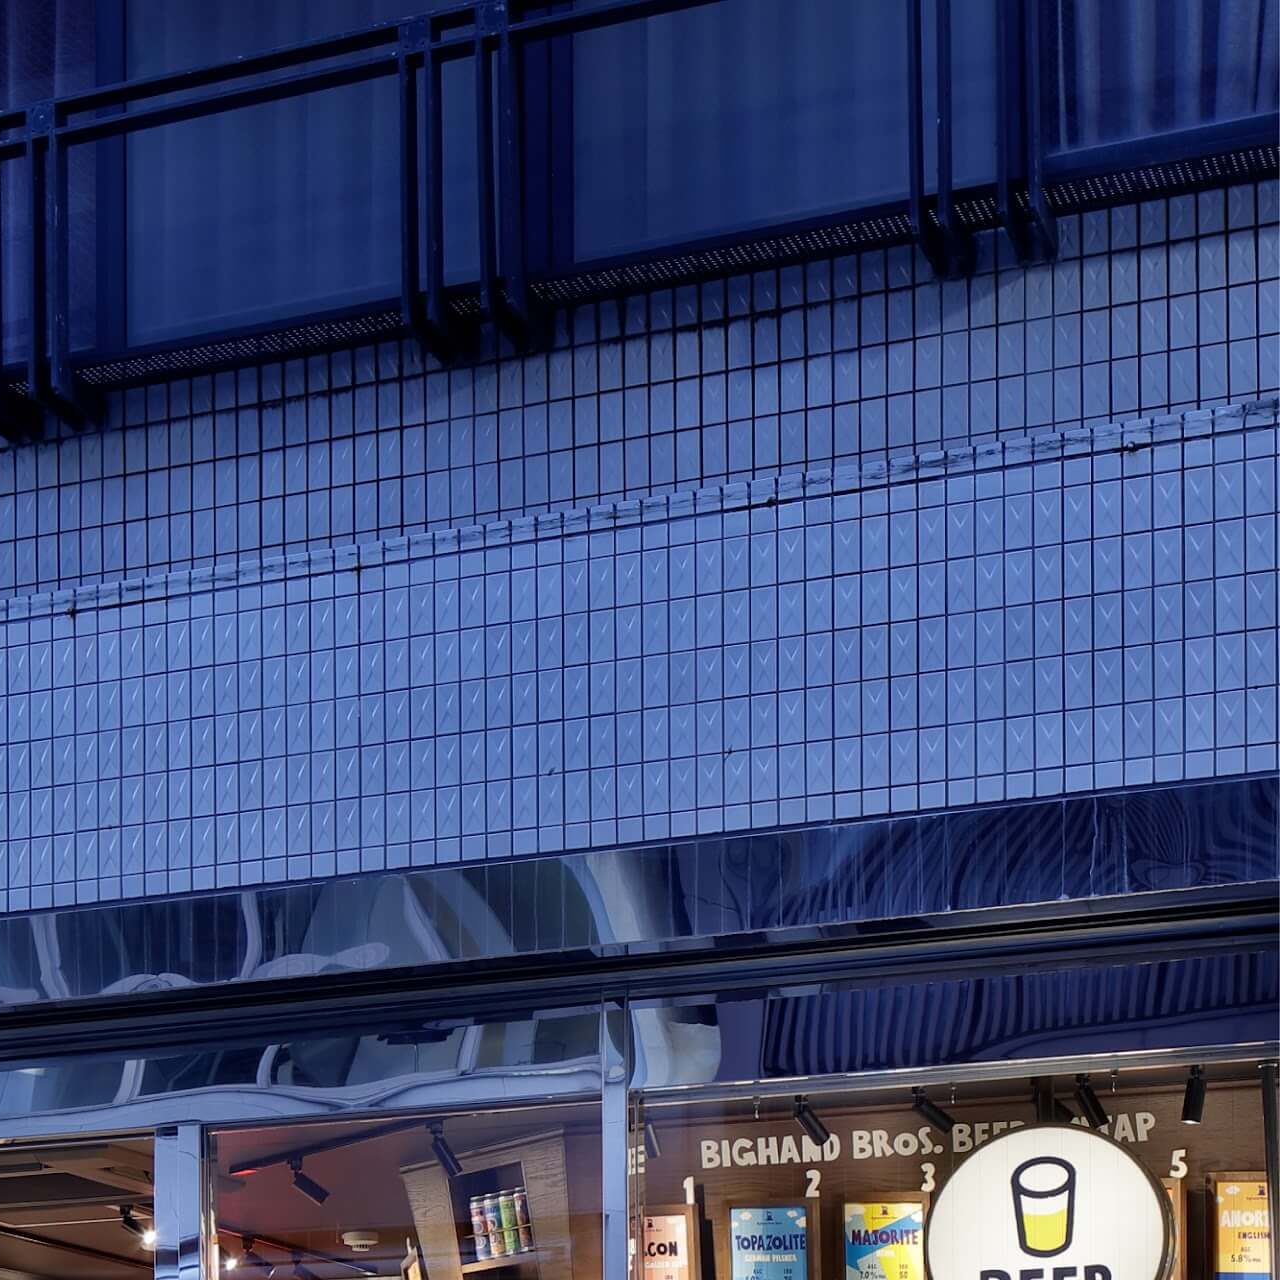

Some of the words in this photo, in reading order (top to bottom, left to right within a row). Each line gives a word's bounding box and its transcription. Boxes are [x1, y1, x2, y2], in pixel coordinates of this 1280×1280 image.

[700, 1133, 841, 1169] BIGHAND
[1170, 1149, 1189, 1179] 5
[683, 1175, 696, 1205] 1
[805, 1169, 821, 1198] 2
[921, 1163, 936, 1193] 3
[735, 1233, 806, 1251] TOPAZOLITE
[851, 1228, 919, 1246] MAJORITE
